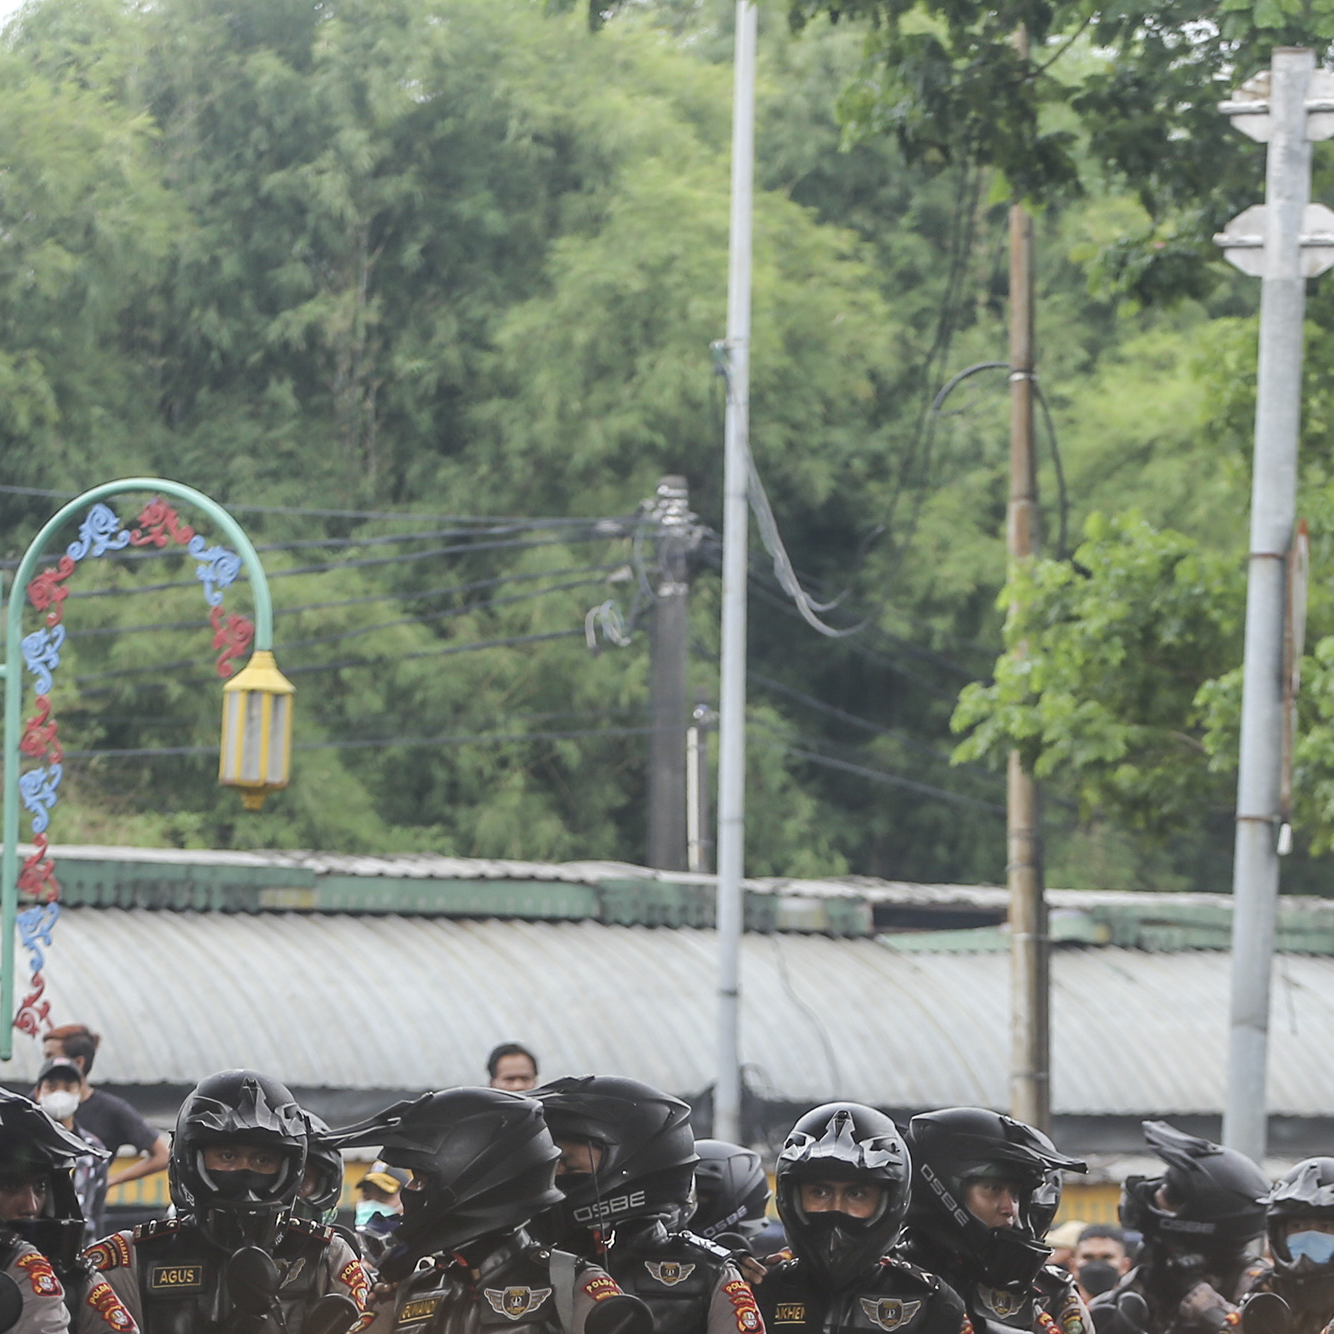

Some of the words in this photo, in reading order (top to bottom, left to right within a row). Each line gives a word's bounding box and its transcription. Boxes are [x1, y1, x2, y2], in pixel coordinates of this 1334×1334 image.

[573, 1190, 646, 1222] OSBE
[920, 1163, 970, 1227] OSBE
[703, 1205, 749, 1238] OSBE
[159, 1269, 195, 1284] AGUS
[341, 1261, 360, 1281] POLD
